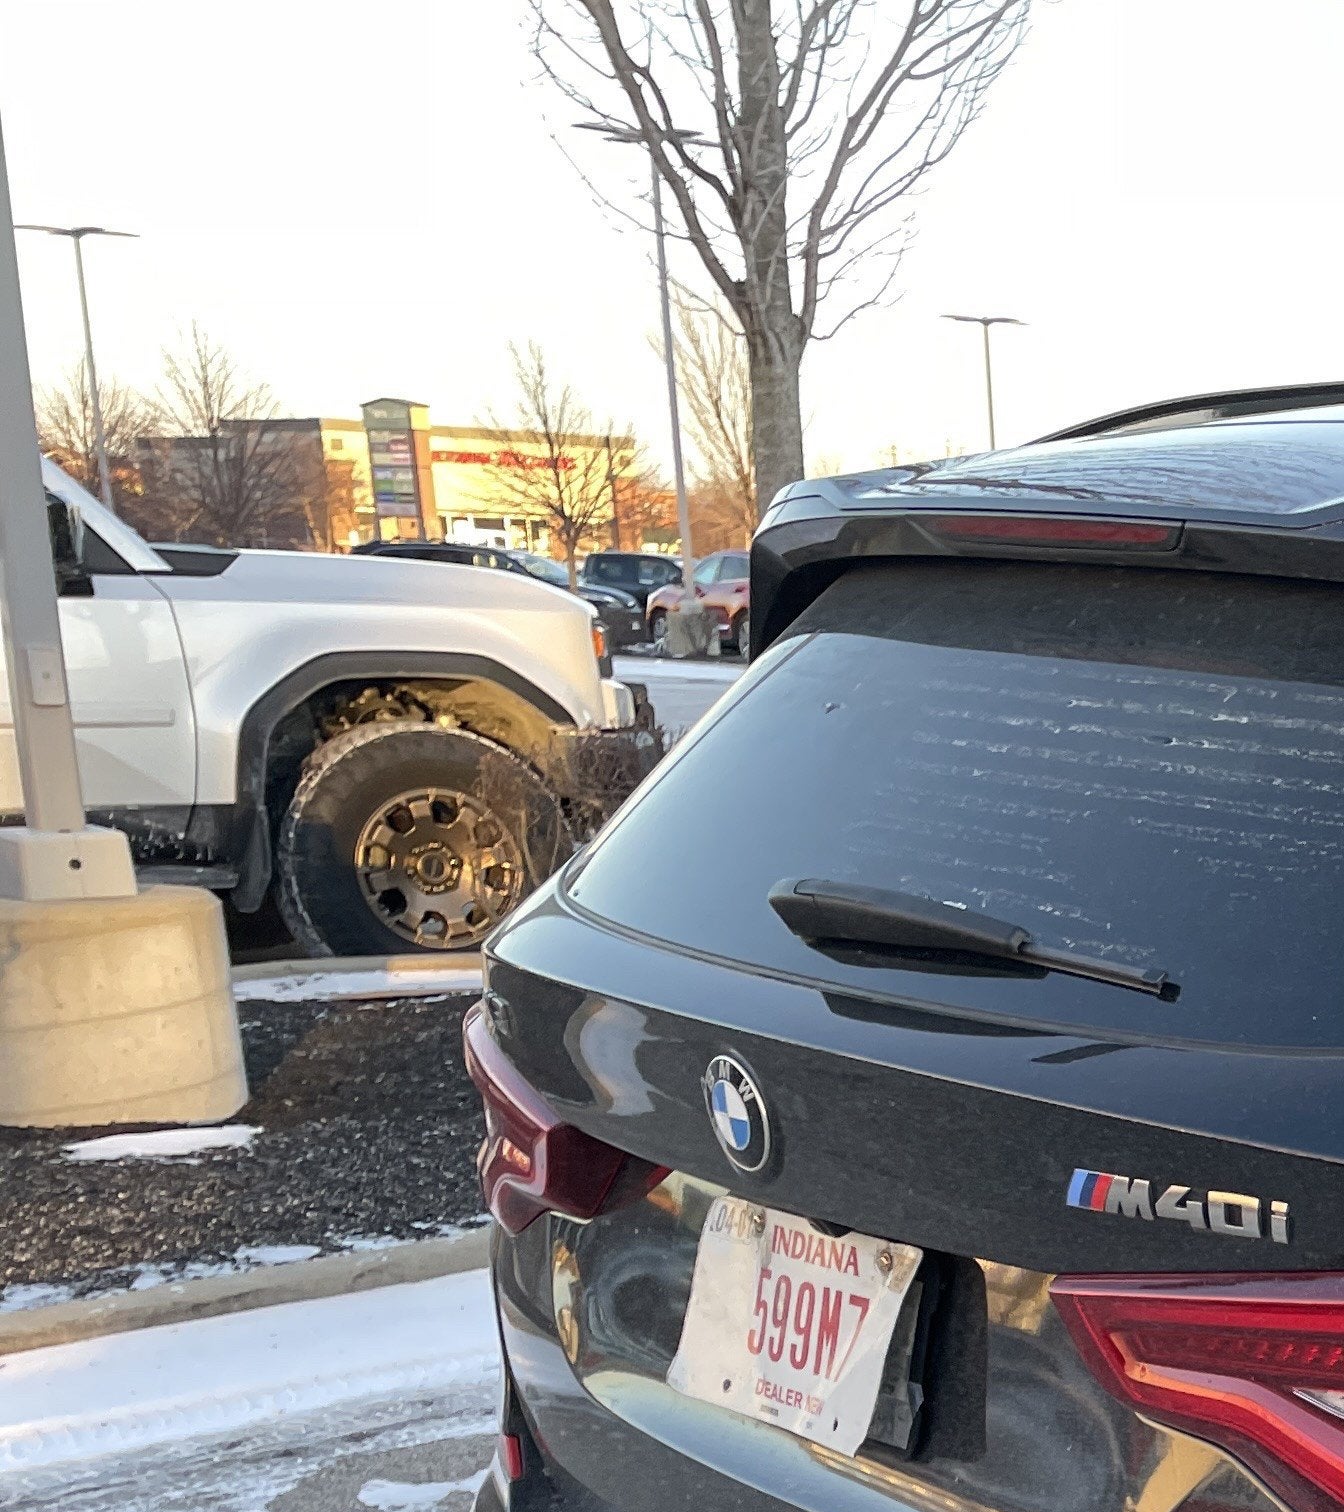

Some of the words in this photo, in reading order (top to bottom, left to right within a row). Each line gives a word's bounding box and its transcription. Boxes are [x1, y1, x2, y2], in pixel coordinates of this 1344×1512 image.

[704, 1059, 756, 1103] BMW
[1104, 1174, 1290, 1245] M40i
[771, 1224, 860, 1278] INDIANA
[746, 1266, 871, 1383] 599M7
[754, 1378, 803, 1410] DEALER
